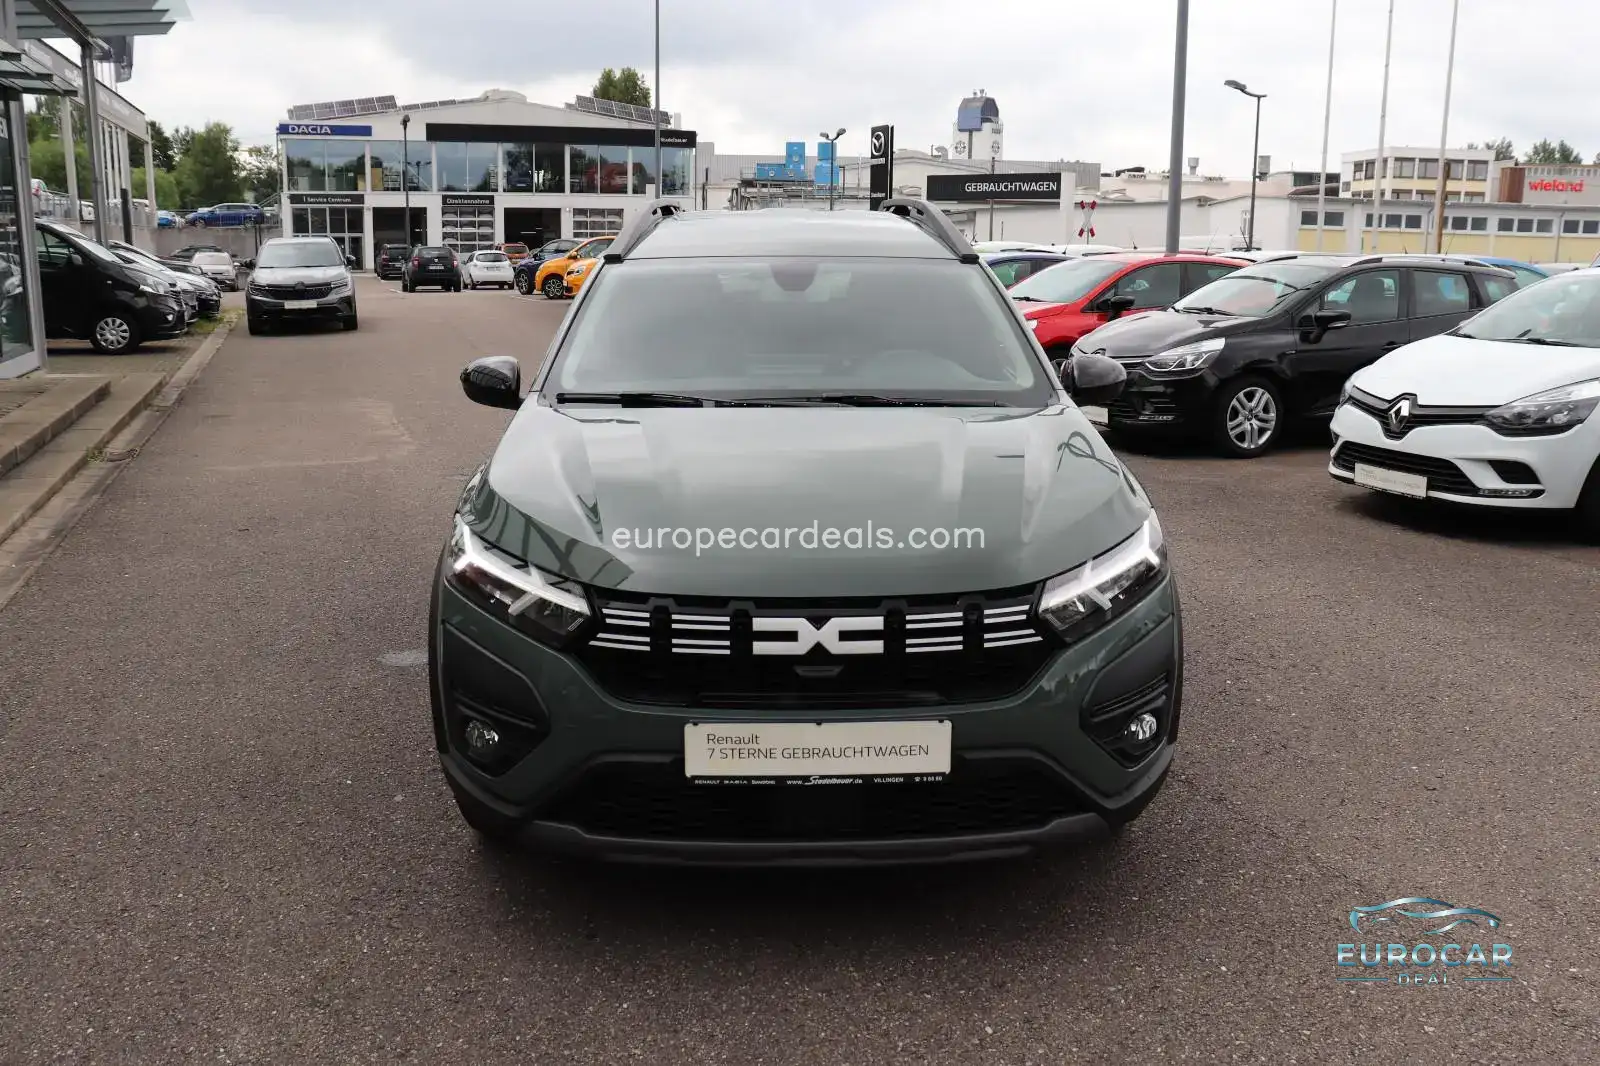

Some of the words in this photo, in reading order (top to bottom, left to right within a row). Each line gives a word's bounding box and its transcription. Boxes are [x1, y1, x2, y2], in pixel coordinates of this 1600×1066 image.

[288, 125, 332, 134] DACIA
[964, 181, 1057, 192] GEBRAUCHTWAGEN
[1528, 178, 1585, 193] wieland
[706, 733, 760, 746] Renault
[707, 748, 715, 760] 7
[719, 747, 778, 760] STERNE
[781, 744, 930, 760] GEBRAUCHTWAGEN
